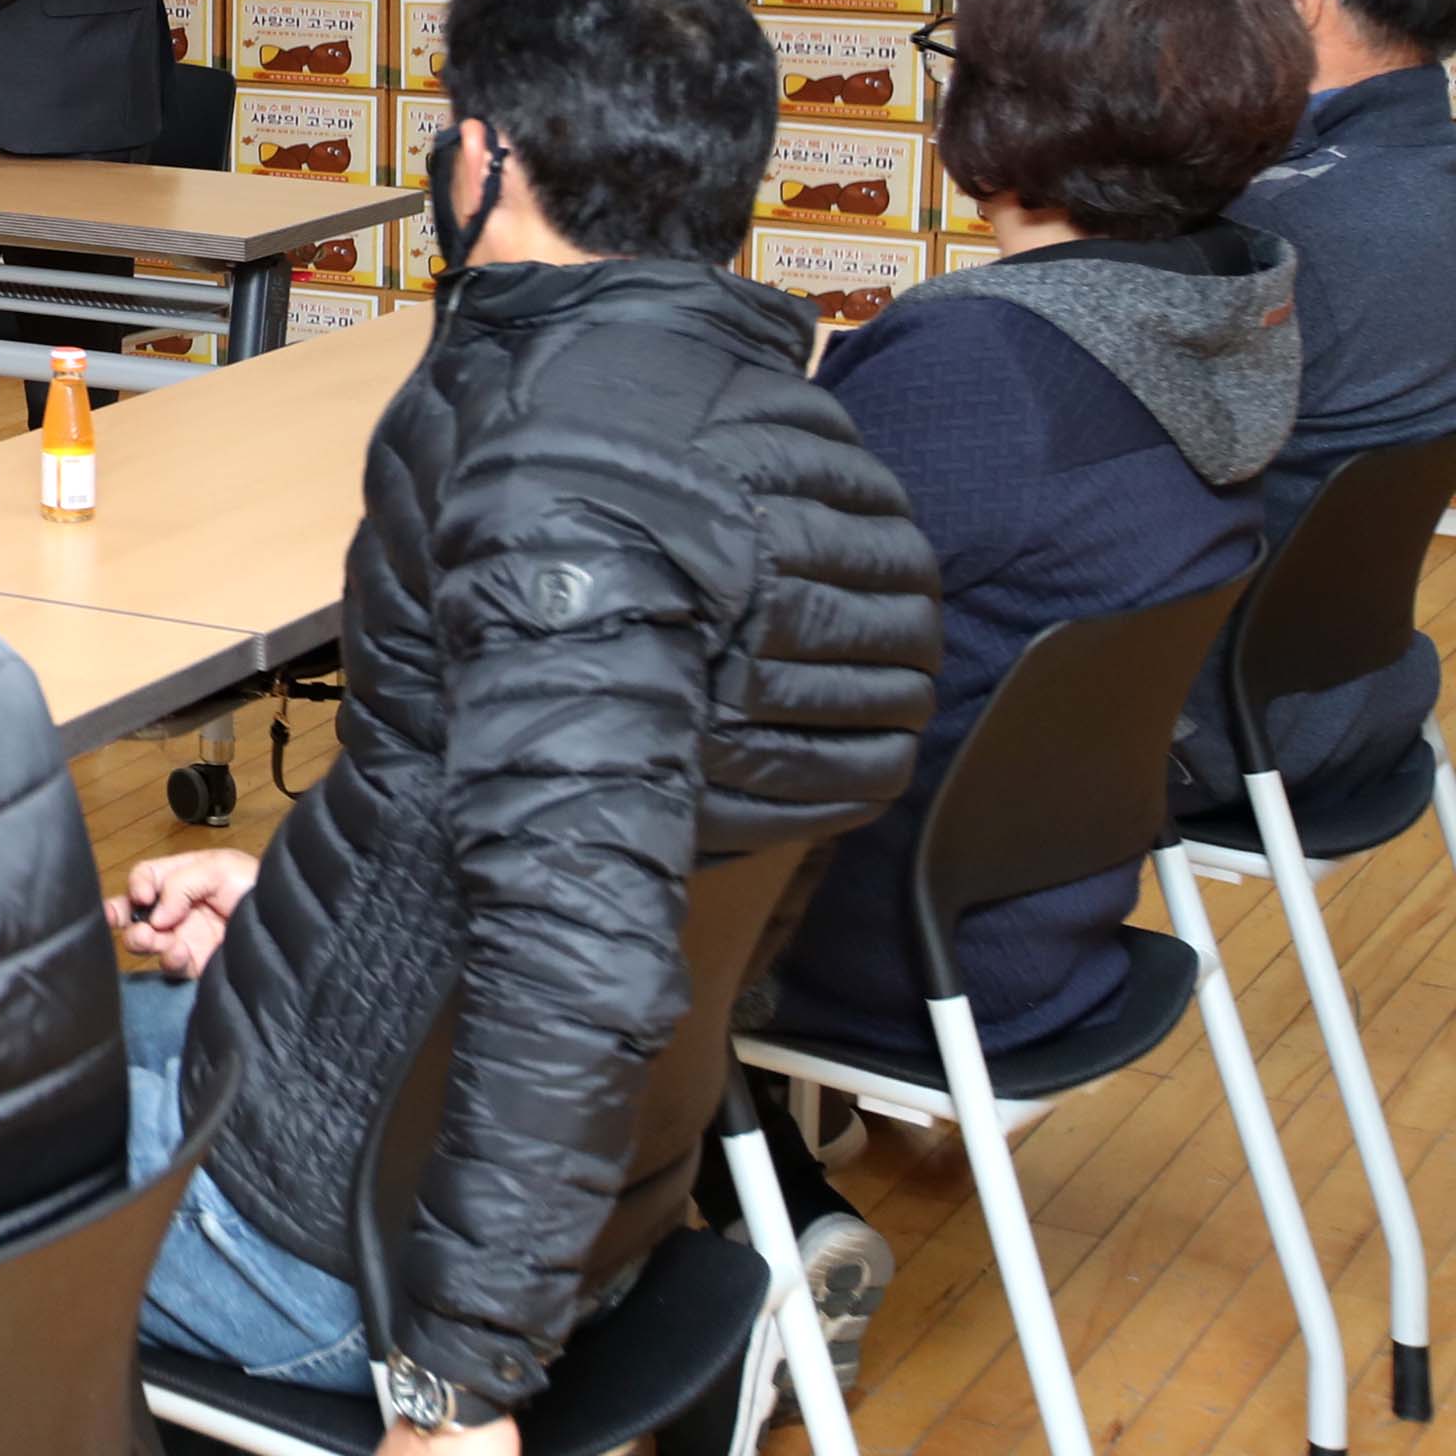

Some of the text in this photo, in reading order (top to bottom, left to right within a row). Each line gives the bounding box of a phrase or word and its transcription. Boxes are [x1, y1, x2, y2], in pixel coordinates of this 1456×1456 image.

[252, 15, 355, 32] 사랑의 고구마
[775, 42, 896, 60] 사랑의 고구마
[251, 112, 354, 130] 사랑의 고구마
[839, 154, 894, 170] 고구마
[775, 255, 898, 277] 사랑의 고구마
